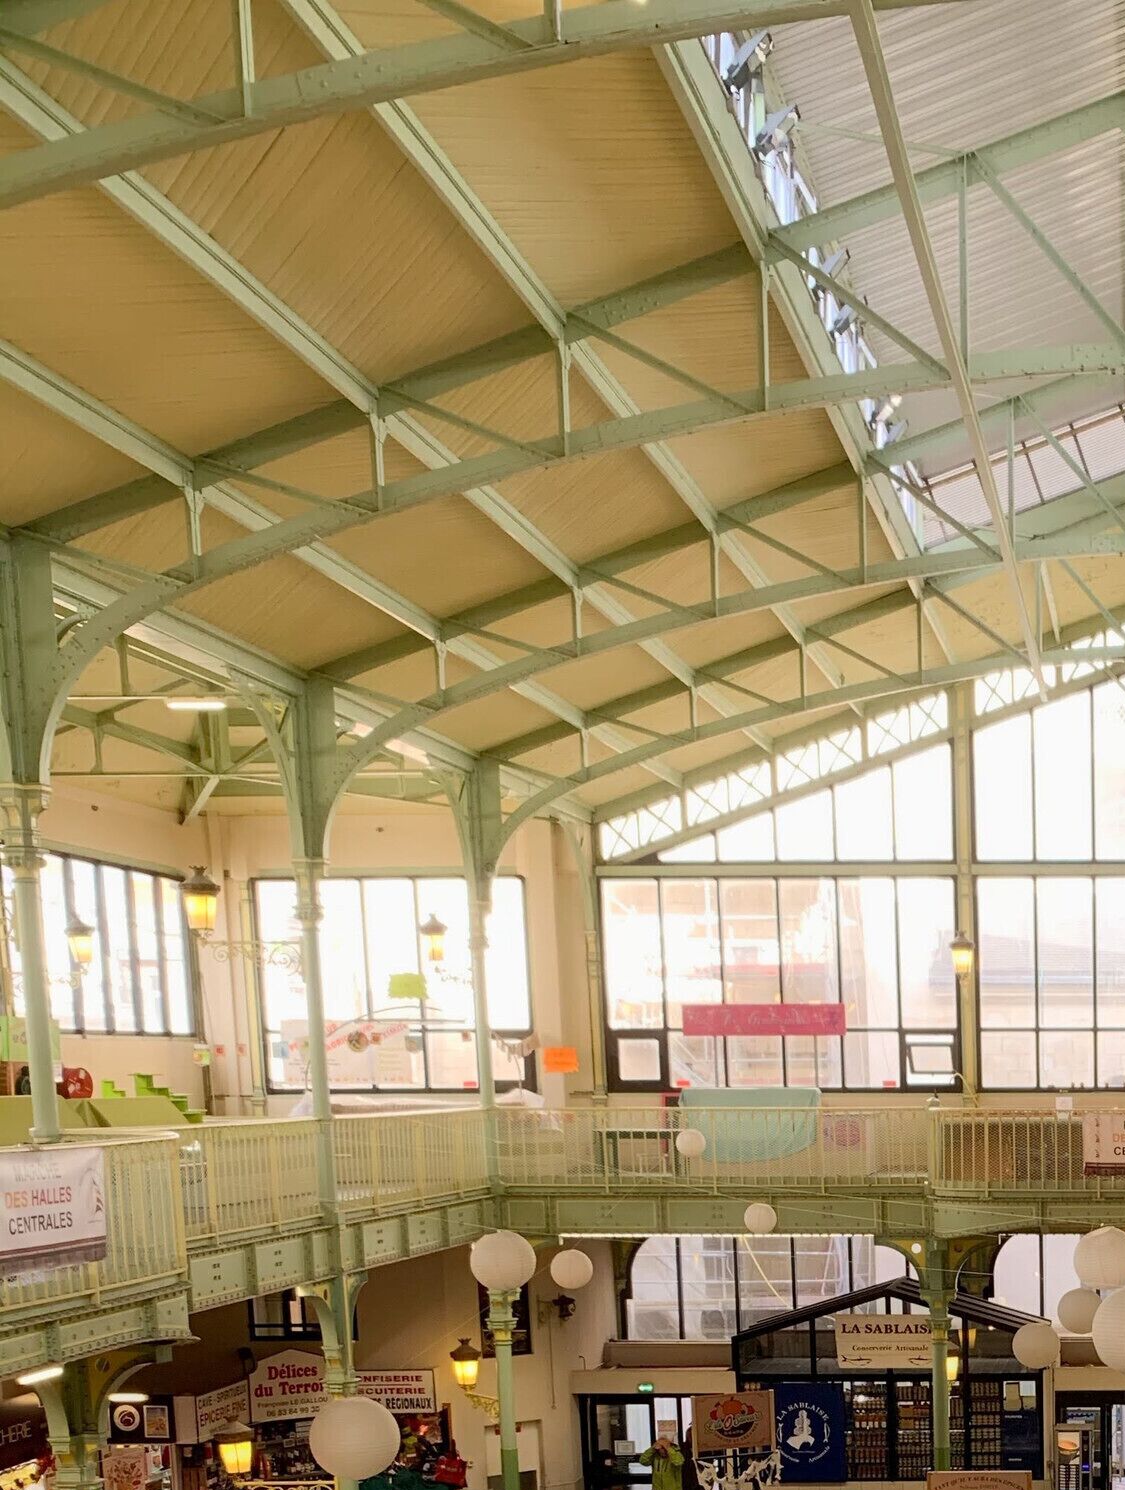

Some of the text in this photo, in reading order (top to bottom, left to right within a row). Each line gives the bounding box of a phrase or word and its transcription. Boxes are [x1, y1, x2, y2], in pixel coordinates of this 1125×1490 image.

[4, 1186, 73, 1209] DES HALLES
[9, 1211, 73, 1236] CENTRALES
[842, 1323, 932, 1335] LA SABLAIS
[267, 1363, 319, 1380] Délices
[355, 1375, 424, 1383] ONFISERIE
[254, 1378, 324, 1398] du Terroi
[357, 1387, 426, 1395] SCUITERIE
[386, 1396, 433, 1410] RÉGIONAUX
[776, 1402, 829, 1420] LA SABLAISE
[0, 1421, 32, 1446] HERIE
